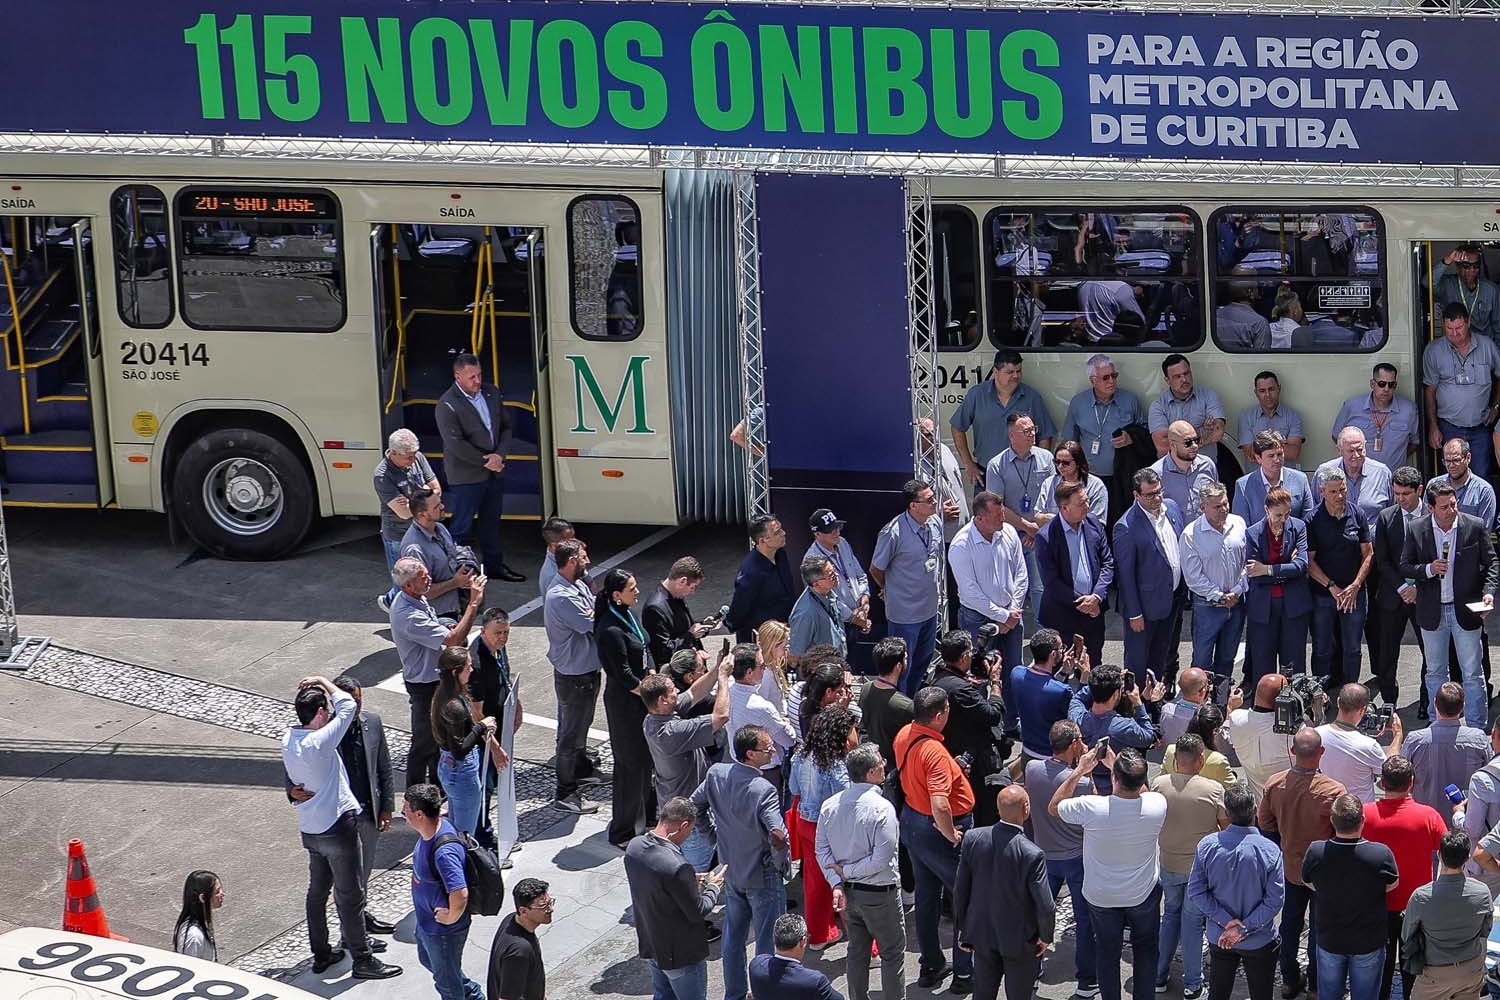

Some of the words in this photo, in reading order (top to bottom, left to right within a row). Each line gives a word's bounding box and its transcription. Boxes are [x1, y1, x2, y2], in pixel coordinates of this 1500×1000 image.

[1088, 34, 1205, 66] PARA
[1214, 37, 1247, 67] A
[1256, 30, 1419, 71] REGIÃO
[184, 13, 321, 121] 115
[340, 16, 668, 130] NOVOS
[691, 9, 1063, 140] ÔNIBUS
[1089, 74, 1459, 113] METROPOLITANA
[1091, 114, 1147, 146] DE
[1157, 116, 1360, 149] CURITIBA
[1, 196, 36, 208] SAÍDA
[439, 205, 476, 218] SAÍDA
[120, 341, 210, 367] 20414
[122, 370, 147, 380] SÃO
[150, 370, 181, 381] JOSÉ
[912, 364, 994, 392] 2041
[565, 356, 656, 434] M
[941, 394, 966, 404] JOS
